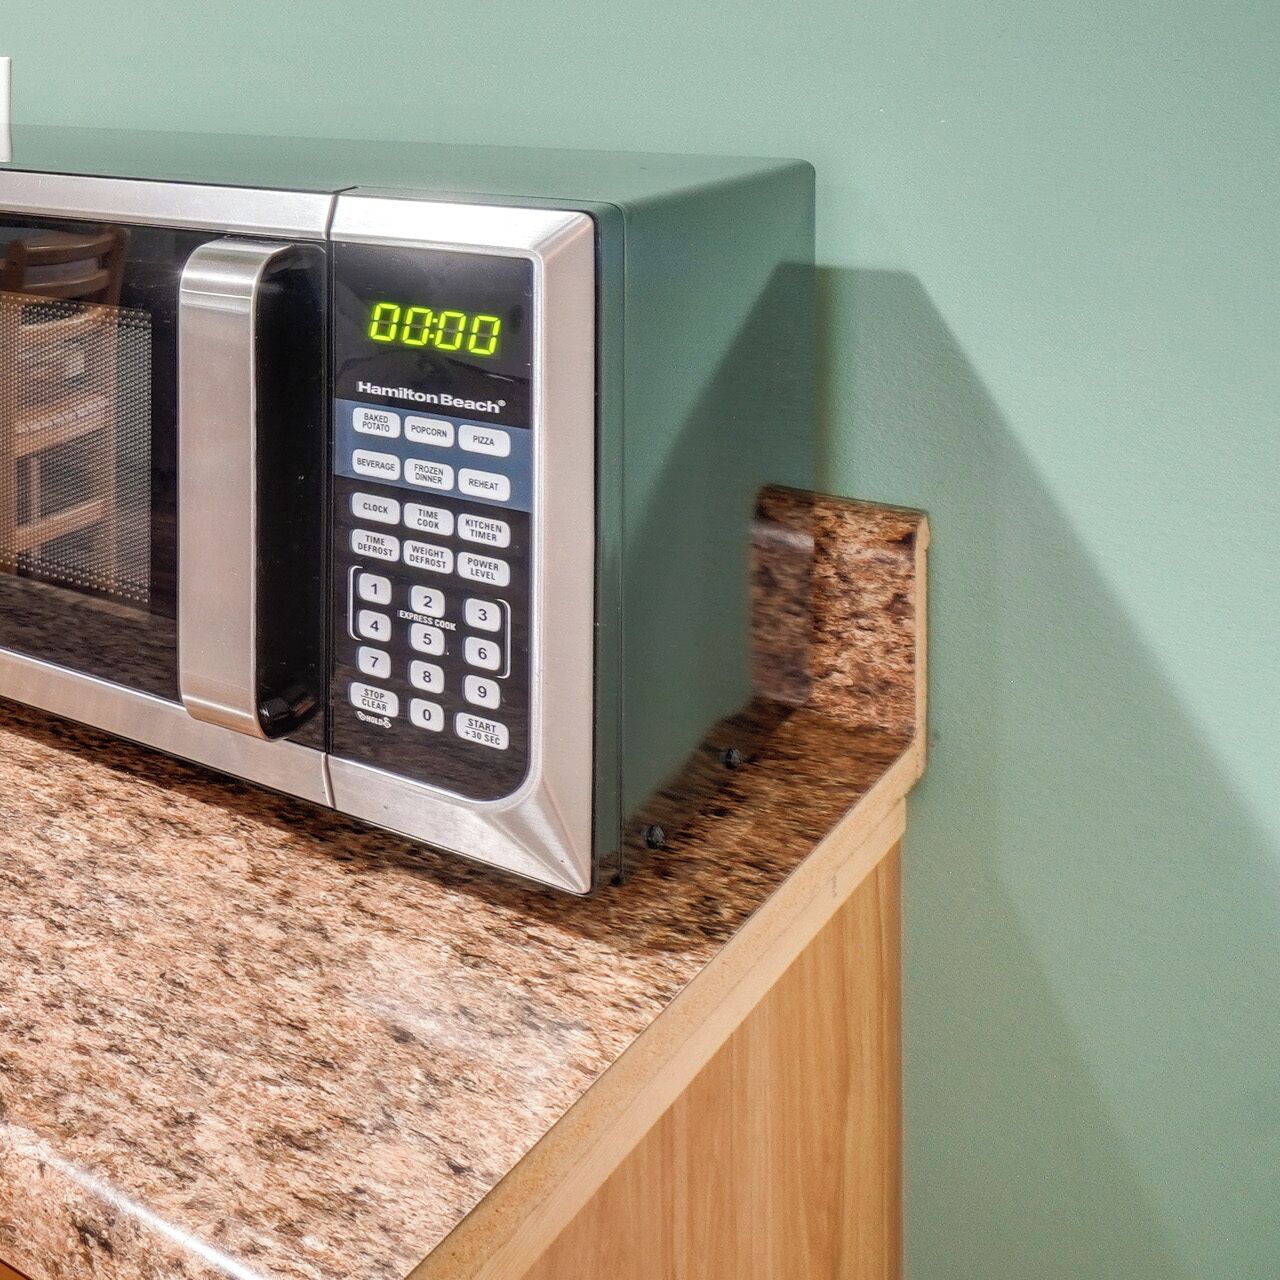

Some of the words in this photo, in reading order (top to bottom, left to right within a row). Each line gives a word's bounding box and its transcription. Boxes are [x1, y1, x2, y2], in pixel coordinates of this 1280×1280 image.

[370, 303, 501, 355] 00:00
[356, 381, 437, 404] Hamilton
[364, 413, 388, 424] BAKED
[362, 421, 390, 433] POTATO
[411, 424, 447, 438] POPCORN
[472, 435, 495, 446] PIZZA
[357, 457, 395, 471] BEVERAGE
[414, 464, 444, 477] FROZEN
[415, 472, 442, 484] DINNER
[468, 478, 498, 491] REHEAT
[363, 502, 389, 514] CLOCK
[418, 509, 438, 520] TIME
[417, 518, 440, 529] COOK
[465, 518, 502, 533] KITCHEN
[365, 534, 385, 545] TIME
[470, 529, 497, 542] TIMER
[358, 544, 393, 557] DEFROST
[411, 545, 444, 558] WEIGHT
[410, 556, 446, 569] DEFROST
[467, 557, 499, 571] POWER
[470, 569, 495, 581] LEVEL
[371, 583, 378, 595] 1
[423, 595, 433, 608] 2
[399, 610, 434, 625] EXPRESS
[434, 619, 456, 631] COOK
[478, 608, 488, 621] 3
[370, 620, 379, 632] 4
[423, 633, 432, 645] 5
[478, 647, 488, 660] 6
[370, 656, 379, 668] 7
[422, 670, 432, 683] 8
[364, 688, 385, 699] STOP
[477, 686, 487, 698] 9
[362, 698, 387, 712] CLEAR
[422, 709, 431, 721] 0
[467, 718, 497, 733] START
[484, 735, 501, 746] SEC
